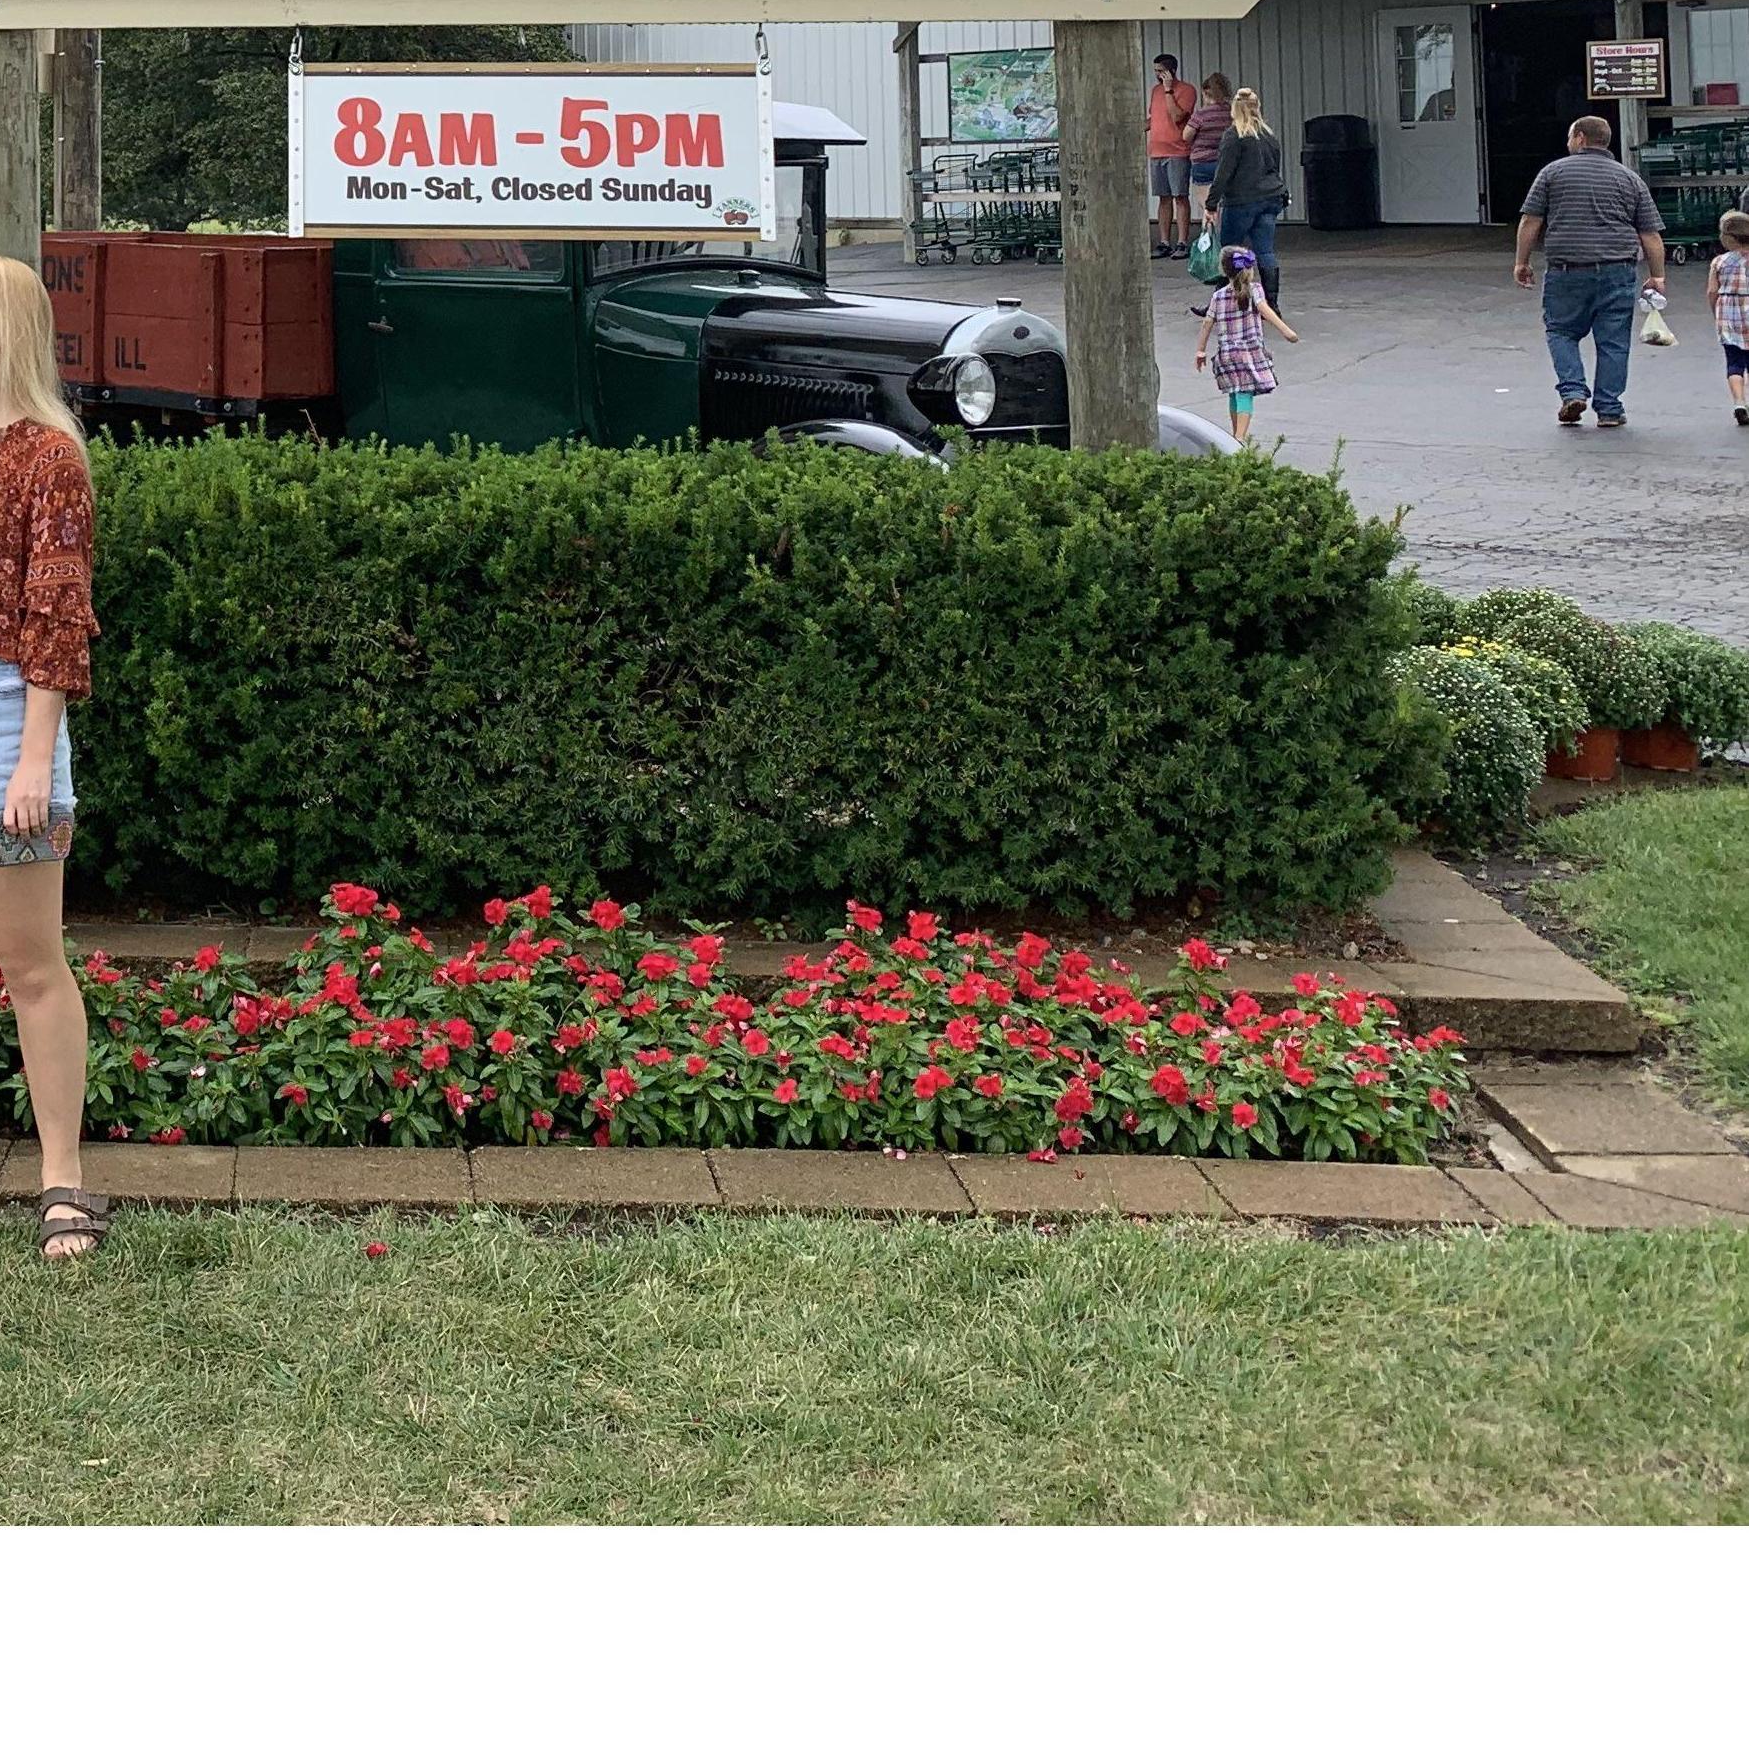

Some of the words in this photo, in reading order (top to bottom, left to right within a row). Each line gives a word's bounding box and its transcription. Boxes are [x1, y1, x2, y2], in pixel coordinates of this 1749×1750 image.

[1596, 46, 1623, 56] Store
[333, 97, 497, 168] 8AM
[516, 132, 544, 145] -
[560, 97, 724, 168] 5PM
[491, 176, 592, 202] Closed
[599, 177, 713, 209] Sunday
[114, 336, 147, 371] ILL
